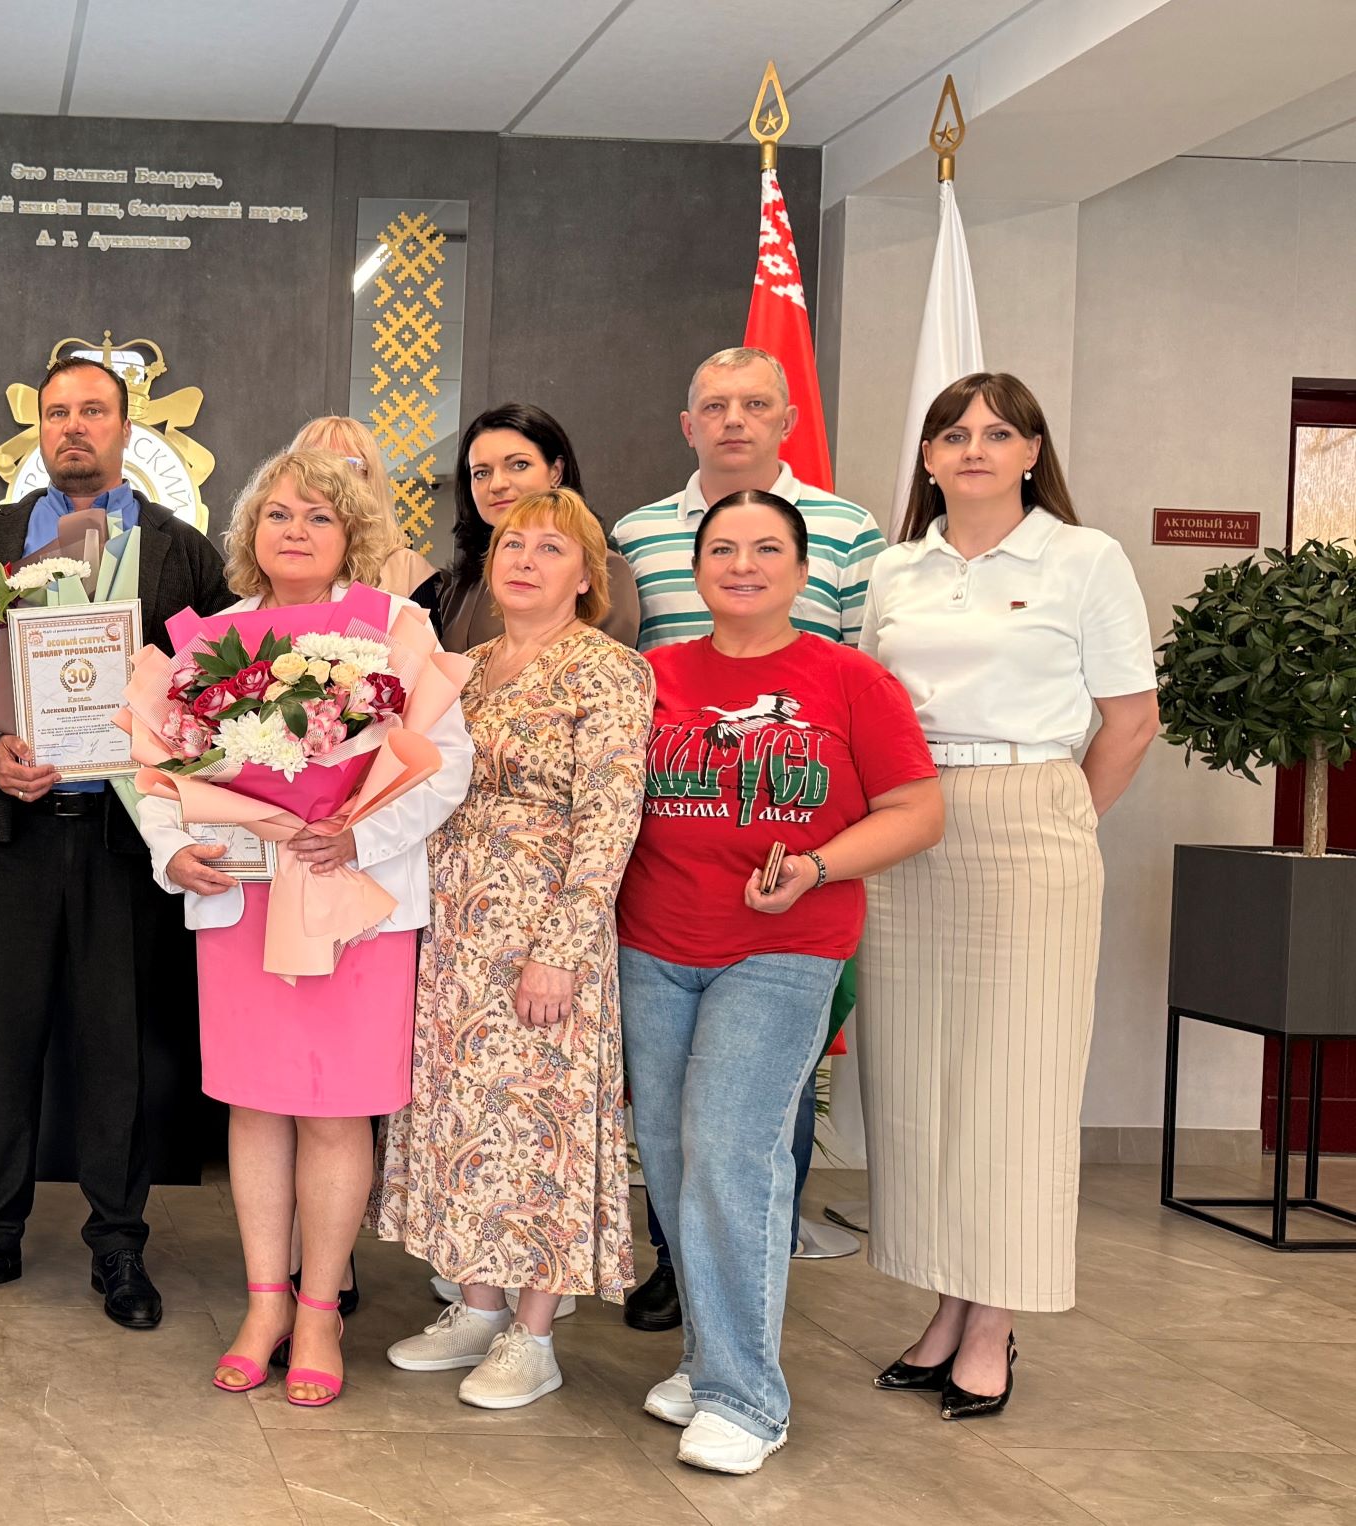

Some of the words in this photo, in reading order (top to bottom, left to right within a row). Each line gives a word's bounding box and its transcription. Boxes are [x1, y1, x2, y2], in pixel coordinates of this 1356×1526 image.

[11, 163, 46, 180] Это
[54, 168, 127, 183] великая
[135, 167, 222, 189] Беларусь,
[19, 199, 82, 215] живём
[88, 202, 124, 219] мы,
[128, 199, 242, 221] белорусский
[36, 229, 56, 246] А.
[62, 230, 78, 247] Г.
[88, 231, 191, 251] Лукашенко
[1164, 518, 1222, 529] АКТОВЫЙ
[1226, 520, 1250, 530] ЗАЛ
[1167, 530, 1217, 539] ASSEMBLY
[1219, 532, 1245, 540] HALL
[68, 668, 90, 684] 30
[759, 807, 814, 823] МАЯ
